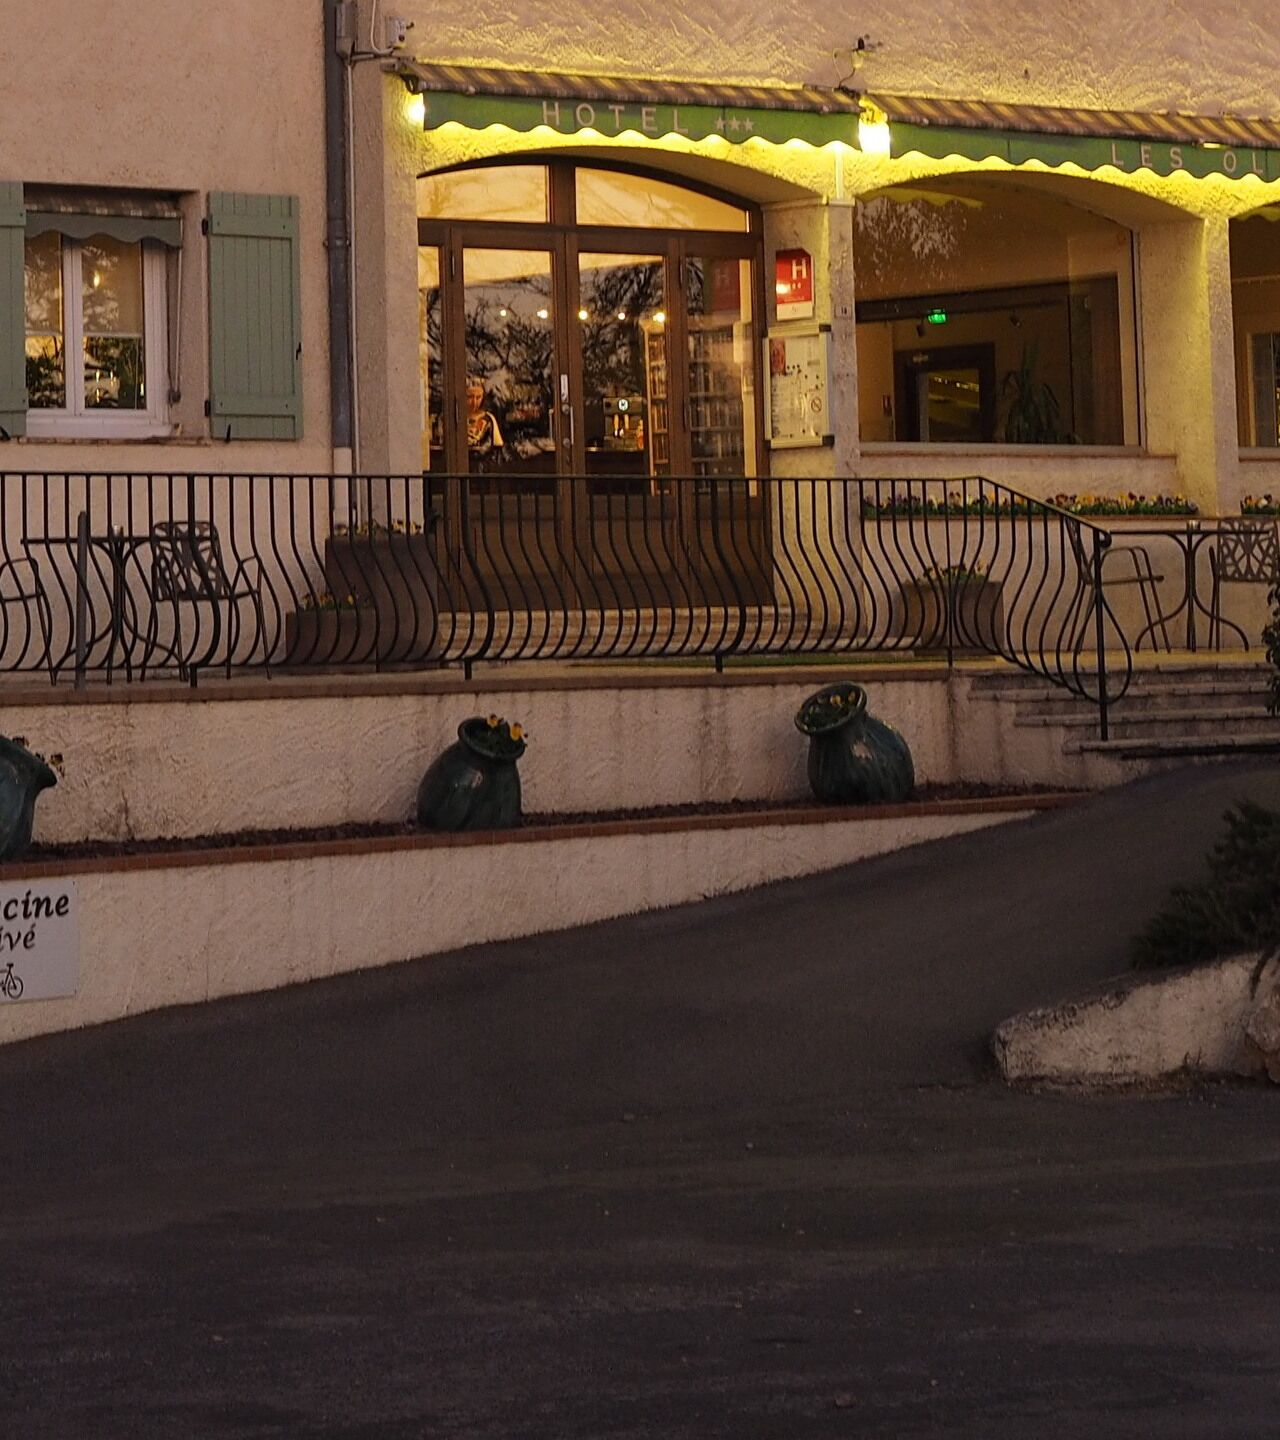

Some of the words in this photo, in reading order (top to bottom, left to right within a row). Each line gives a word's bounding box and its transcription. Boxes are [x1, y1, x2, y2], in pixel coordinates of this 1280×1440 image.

[541, 100, 689, 134] HOTEL
[1111, 142, 1183, 169] LES
[791, 258, 807, 280] H
